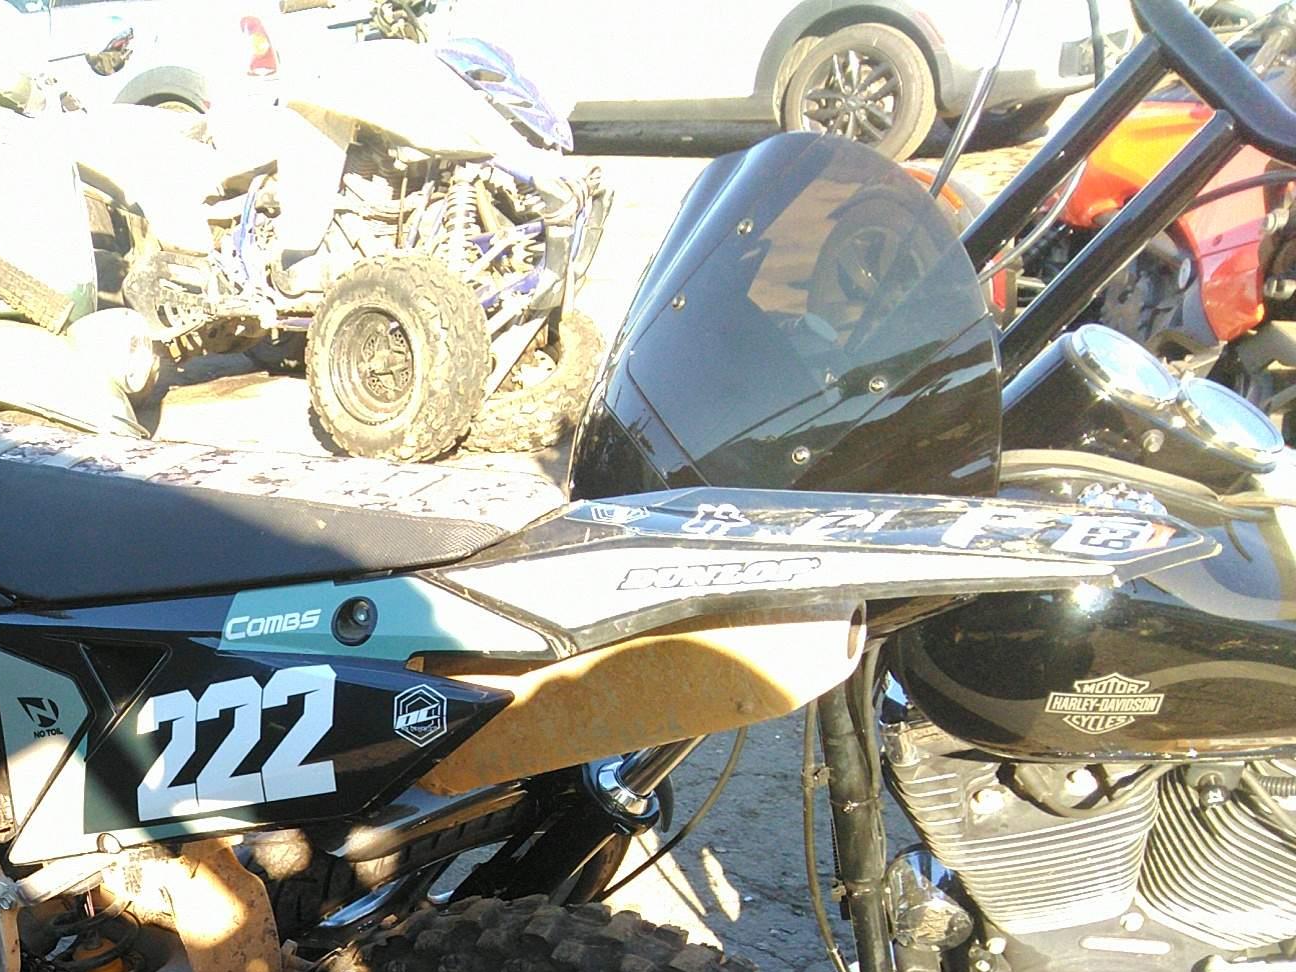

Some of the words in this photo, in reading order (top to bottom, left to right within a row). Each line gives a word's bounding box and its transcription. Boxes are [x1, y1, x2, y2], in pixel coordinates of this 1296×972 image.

[616, 557, 818, 591] DUNLOP
[1082, 677, 1140, 694] MOTOR
[1052, 695, 1158, 713] HARLEY-DAVIDSON
[1071, 715, 1128, 732] CYCLES
[33, 730, 46, 739] NO
[135, 663, 338, 823] 222
